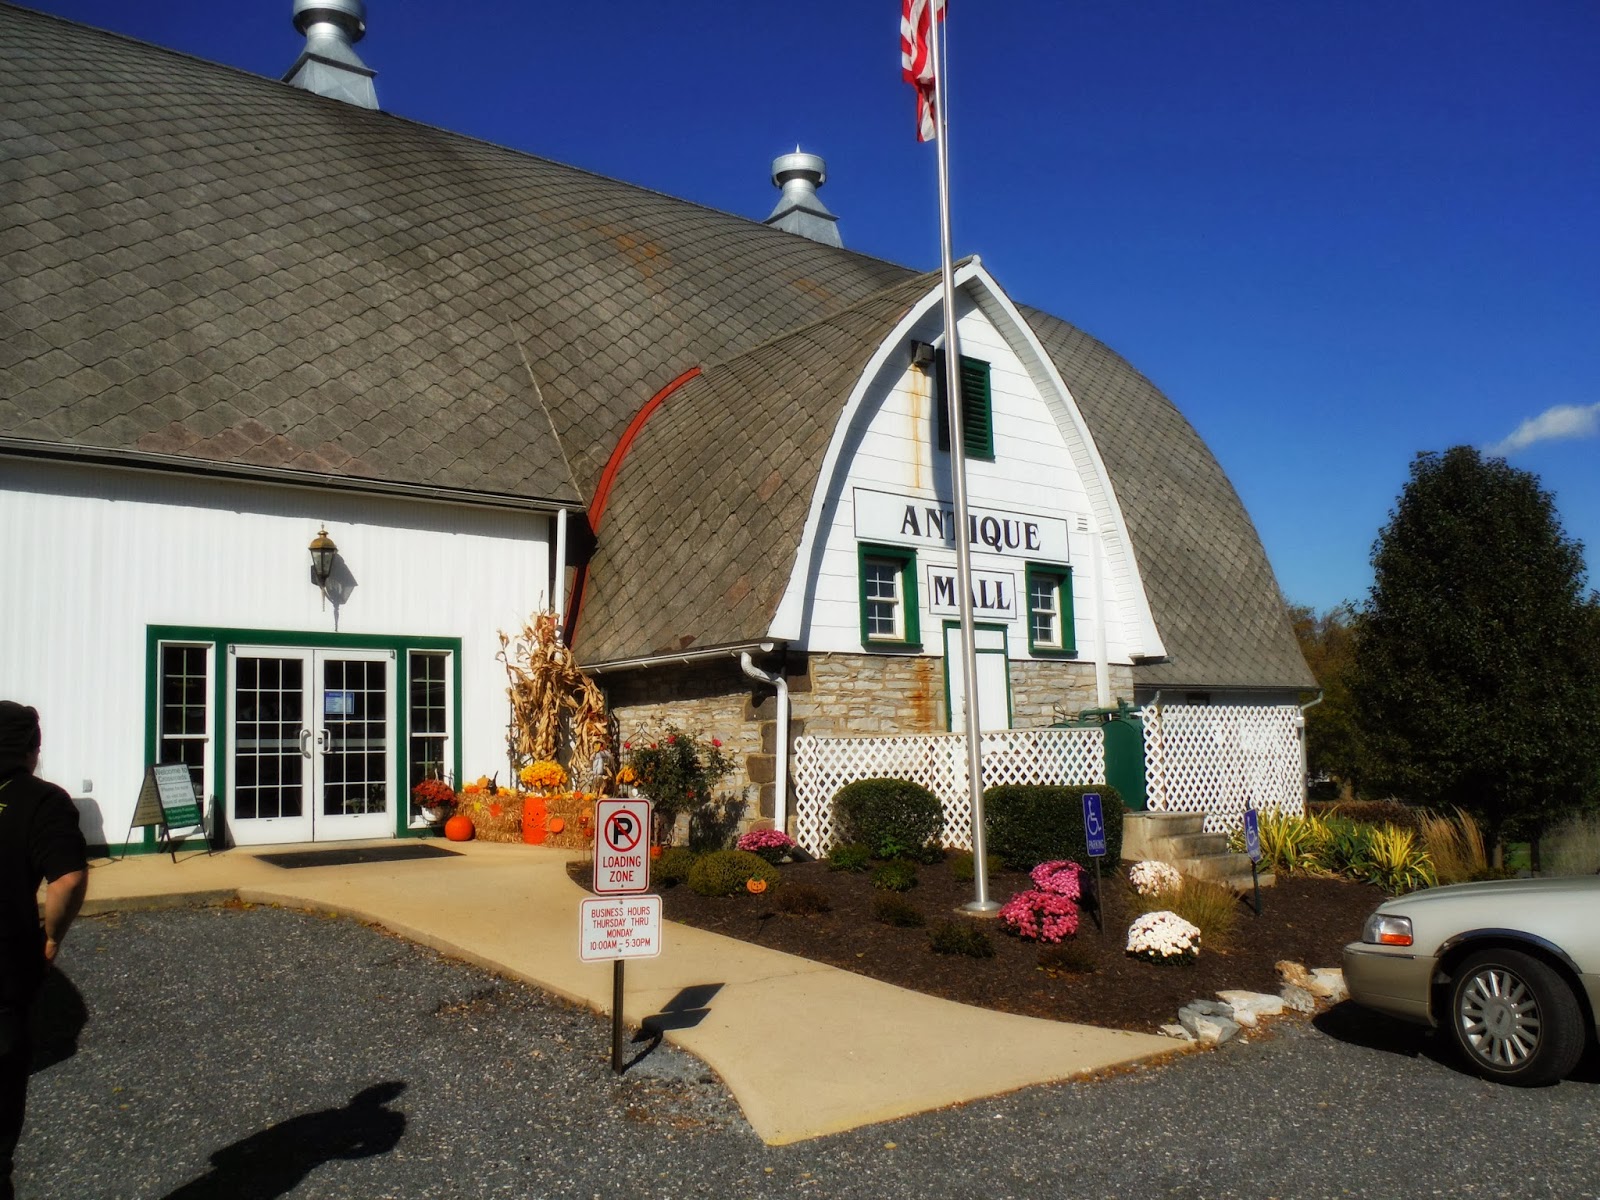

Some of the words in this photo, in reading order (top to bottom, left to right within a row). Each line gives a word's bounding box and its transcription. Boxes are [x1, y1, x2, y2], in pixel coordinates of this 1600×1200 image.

[933, 575, 1011, 610] MLL
[602, 855, 641, 868] LOADING
[609, 870, 634, 883] ZONE
[591, 907, 624, 918] BUSINESS
[627, 906, 650, 916] HOURS
[593, 918, 626, 929] THURSDAY
[631, 917, 649, 927] THRU
[606, 928, 633, 938] MONDAY
